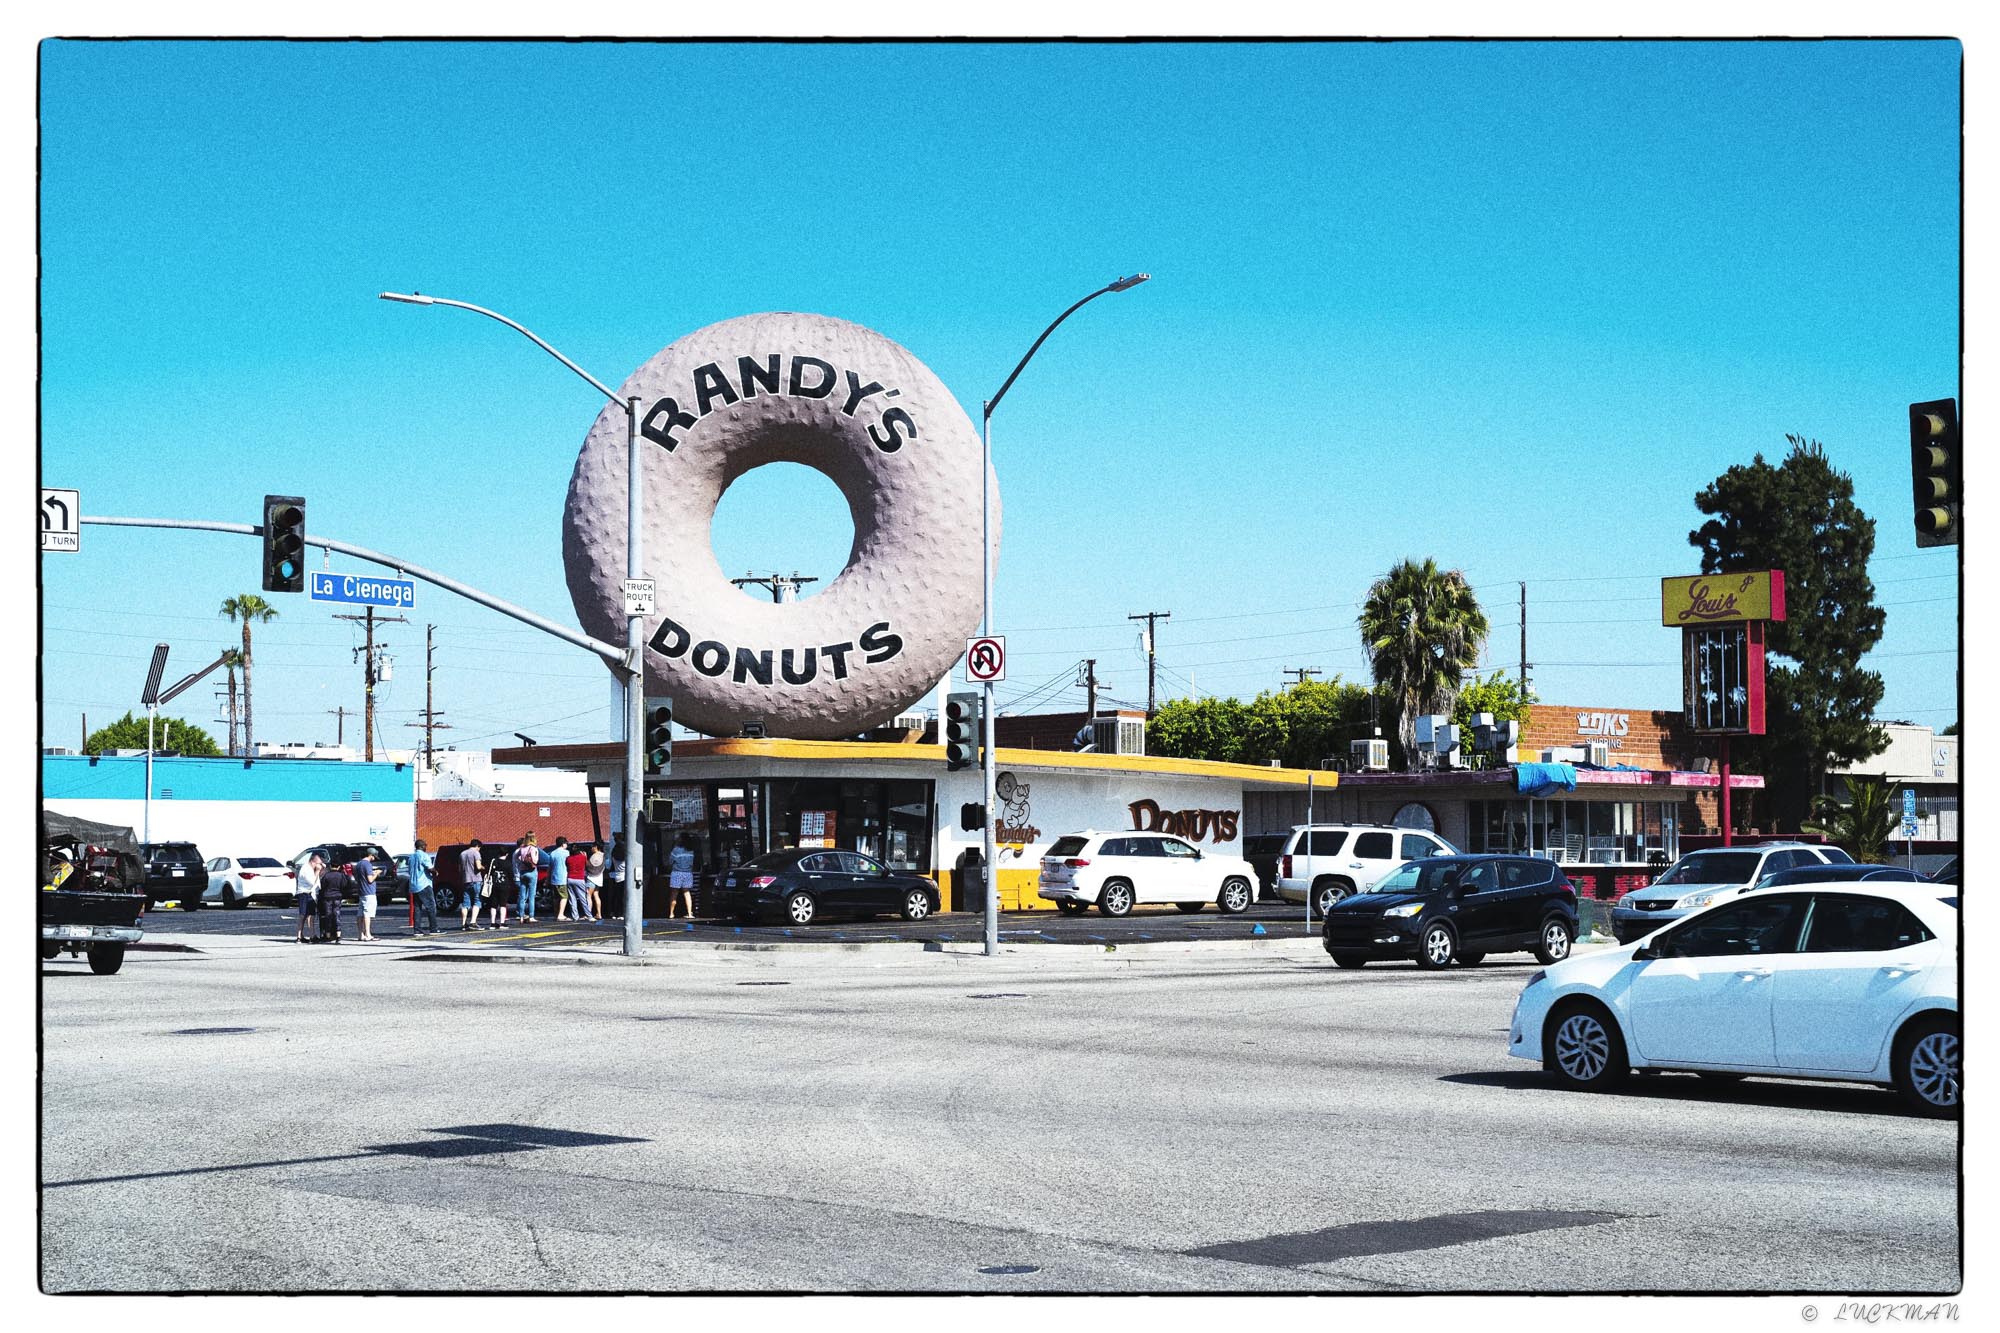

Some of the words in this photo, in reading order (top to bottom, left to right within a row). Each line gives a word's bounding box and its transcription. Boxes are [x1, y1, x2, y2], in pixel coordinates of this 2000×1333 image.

[641, 353, 919, 454] RANDY'S
[52, 536, 76, 546] TURN
[313, 573, 334, 595] La
[343, 576, 412, 607] Cienega
[626, 582, 653, 591] TRUCK
[626, 592, 653, 602] ROUTE
[646, 617, 905, 686] DONUTS
